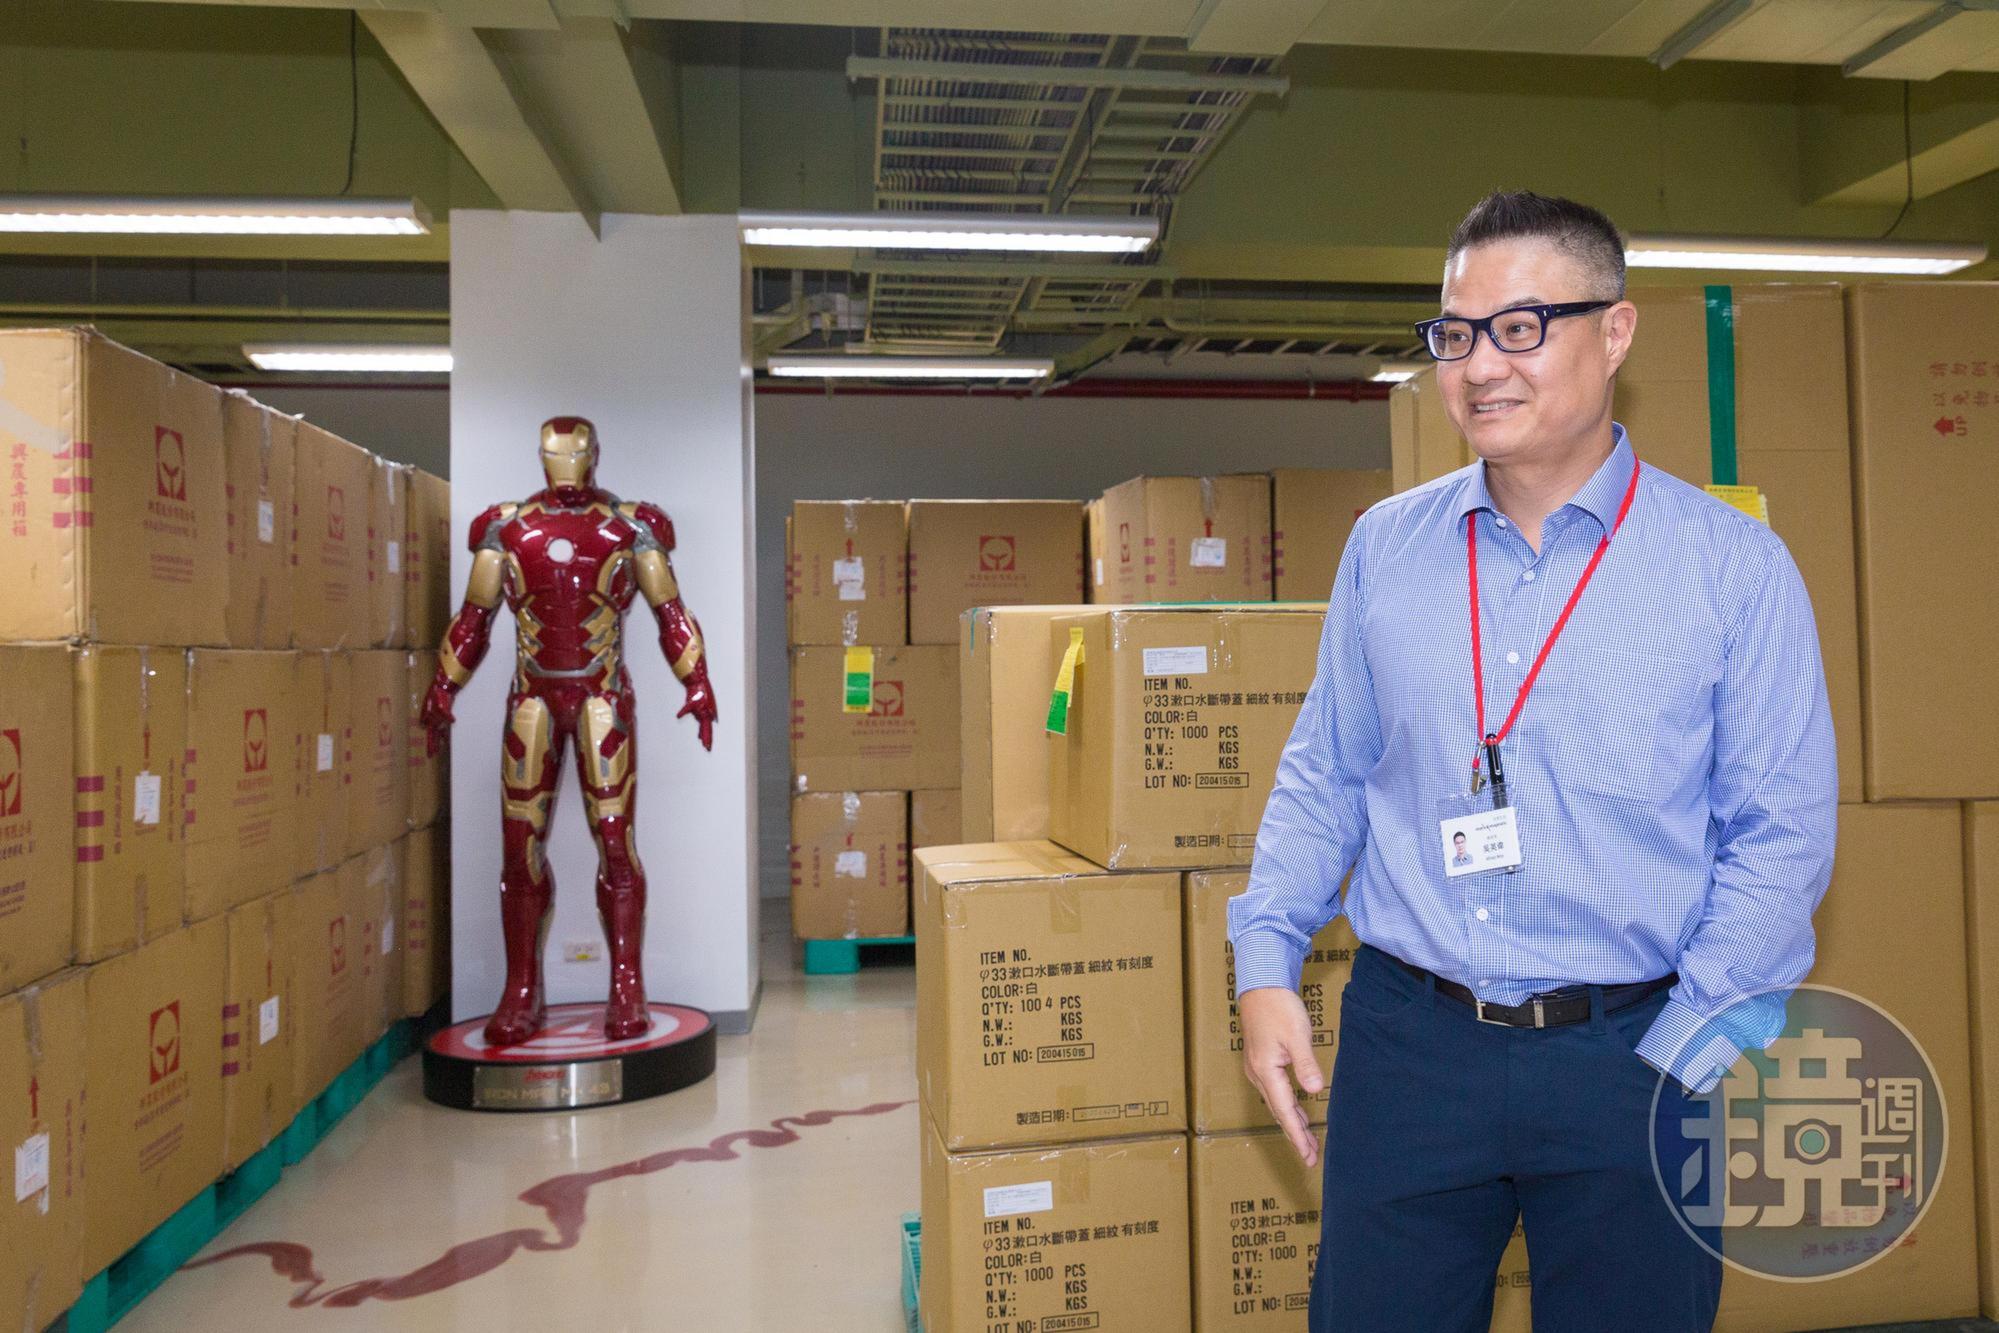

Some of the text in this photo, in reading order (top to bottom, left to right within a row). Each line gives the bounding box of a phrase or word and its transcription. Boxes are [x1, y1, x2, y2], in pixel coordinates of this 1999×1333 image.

[1955, 415, 1968, 437] UP
[1144, 677, 1193, 691] ITEM NO.
[1246, 692, 1270, 705] 細紋
[1144, 725, 1239, 740] Q'TY: 1000 PCS
[1145, 741, 1239, 756] N.W.: KGS
[1145, 756, 1239, 771] G.W.: KGS
[1145, 775, 1166, 789] LOT
[1173, 774, 1191, 788] NO:
[980, 948, 1031, 966] ITEM NO.
[1088, 959, 1113, 973] 細紋
[1116, 955, 1154, 971] 有刻度
[1303, 984, 1323, 997] PCS
[981, 1001, 1013, 1016] Q'TY:
[1060, 995, 1082, 1009] PCS
[982, 1011, 1083, 1032] N.W.: KGS
[983, 1027, 1083, 1047] G.W.: KGS
[984, 1051, 1007, 1067] LOT
[1013, 1049, 1033, 1063] NO:
[1016, 1109, 1070, 1126] 製造日期:
[1230, 1197, 1279, 1214] ITEM NO.
[984, 1217, 1035, 1235] ITEM NO.
[1093, 1225, 1119, 1240] 細紋
[1121, 1220, 1160, 1236] 有刻度
[1232, 1244, 1320, 1264] Q'TY: 1000 PC
[985, 1263, 1086, 1287] Q'TY: 1000 PCS
[1233, 1267, 1262, 1280] N.W.:
[986, 1280, 1087, 1303] N.W.: KGS
[1233, 1282, 1262, 1296] G.W.:
[986, 1297, 1087, 1319] G.W.: KGS
[1234, 1300, 1255, 1315] LOT
[1262, 1296, 1281, 1311] NO:
[1017, 1320, 1037, 1333] NO:
